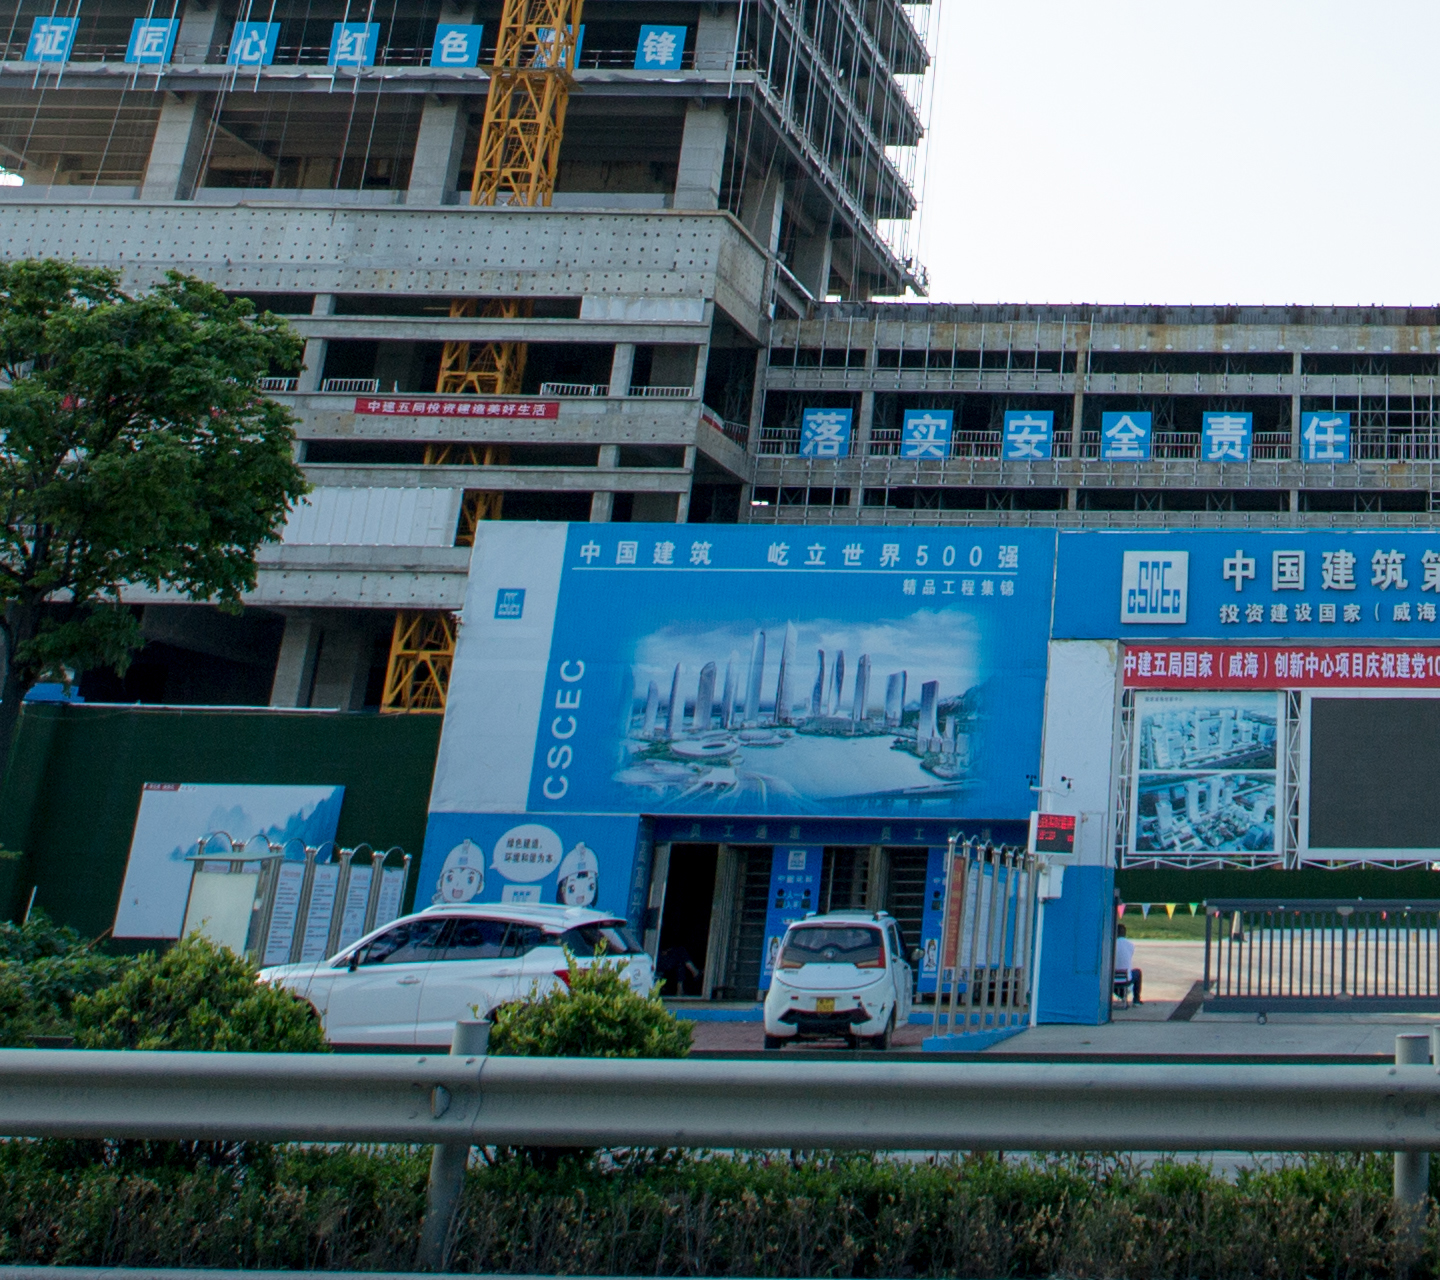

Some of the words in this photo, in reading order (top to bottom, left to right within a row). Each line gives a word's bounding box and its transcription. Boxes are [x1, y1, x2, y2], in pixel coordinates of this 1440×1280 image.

[368, 401, 546, 416] 中建五局投资建造美好生活
[805, 413, 1346, 460] 落实安全责任
[579, 540, 712, 566] 中国建筑
[767, 541, 1019, 569] 屹立世界500强
[902, 578, 1015, 598] 精品工程集锦
[543, 659, 586, 800] CSCEC
